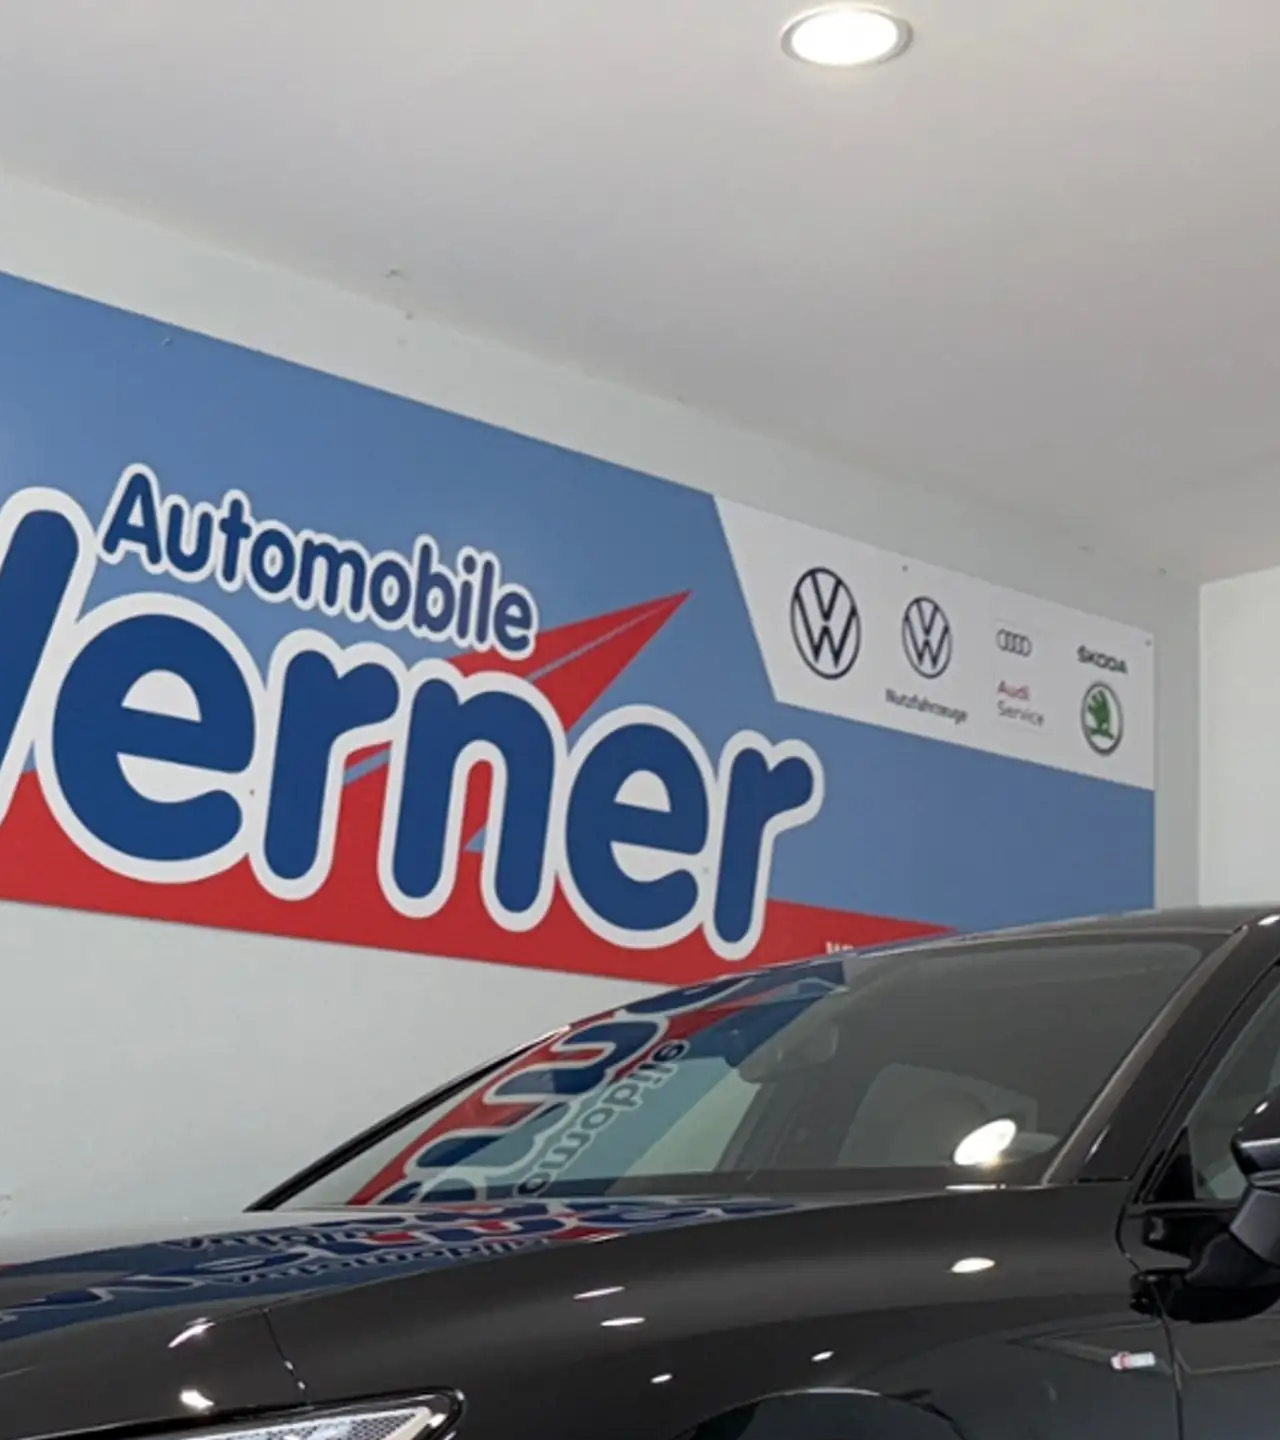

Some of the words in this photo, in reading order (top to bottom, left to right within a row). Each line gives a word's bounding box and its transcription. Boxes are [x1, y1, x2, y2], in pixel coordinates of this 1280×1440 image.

[100, 468, 534, 652] Automobile
[885, 687, 969, 726] Nutzfahrzeuge
[997, 680, 1031, 701] Audi
[997, 699, 1045, 727] Service
